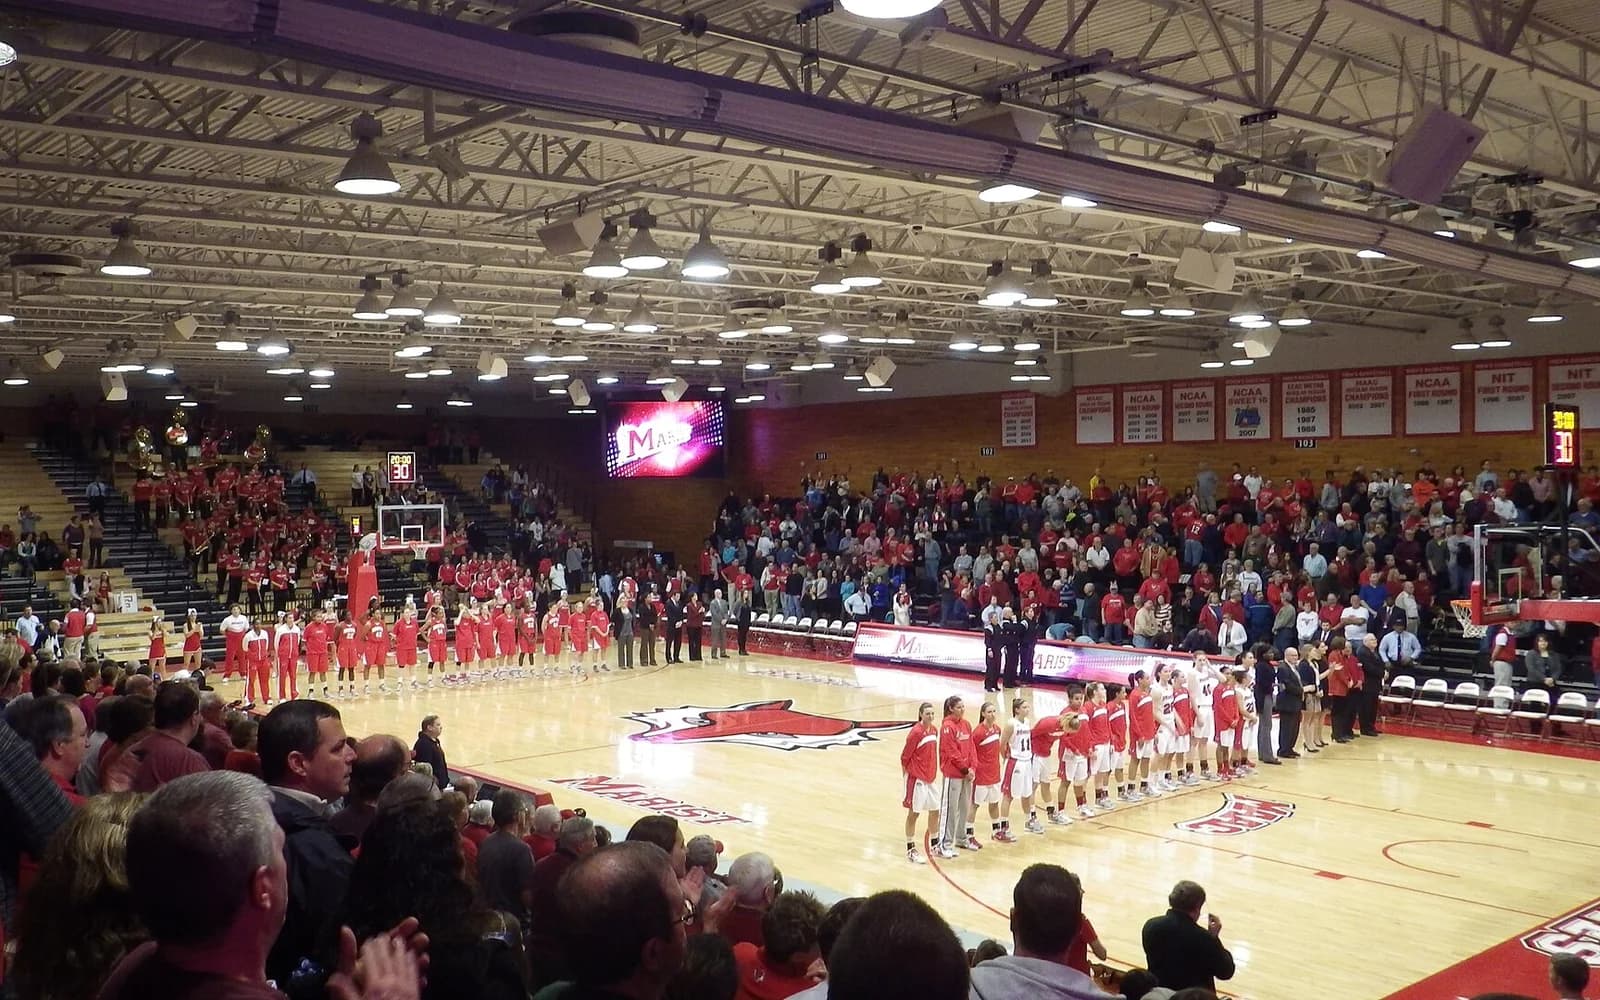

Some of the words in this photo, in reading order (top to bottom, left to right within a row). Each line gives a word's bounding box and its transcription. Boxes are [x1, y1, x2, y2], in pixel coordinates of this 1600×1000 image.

[1492, 373, 1515, 384] NIT
[1568, 369, 1592, 379] NIT
[1416, 379, 1450, 388] NCAA
[1180, 391, 1207, 401] NCAA
[1233, 387, 1262, 396] NCAA
[1345, 392, 1389, 401] CHAMPIONS
[1431, 389, 1457, 397] ROUND
[1130, 395, 1156, 403] NCAA
[1299, 440, 1314, 448] 103
[390, 455, 412, 465] 20:00
[393, 464, 409, 480] 30
[1034, 654, 1073, 669] ARIST
[1020, 738, 1030, 752] 11
[548, 775, 753, 824] MARIST
